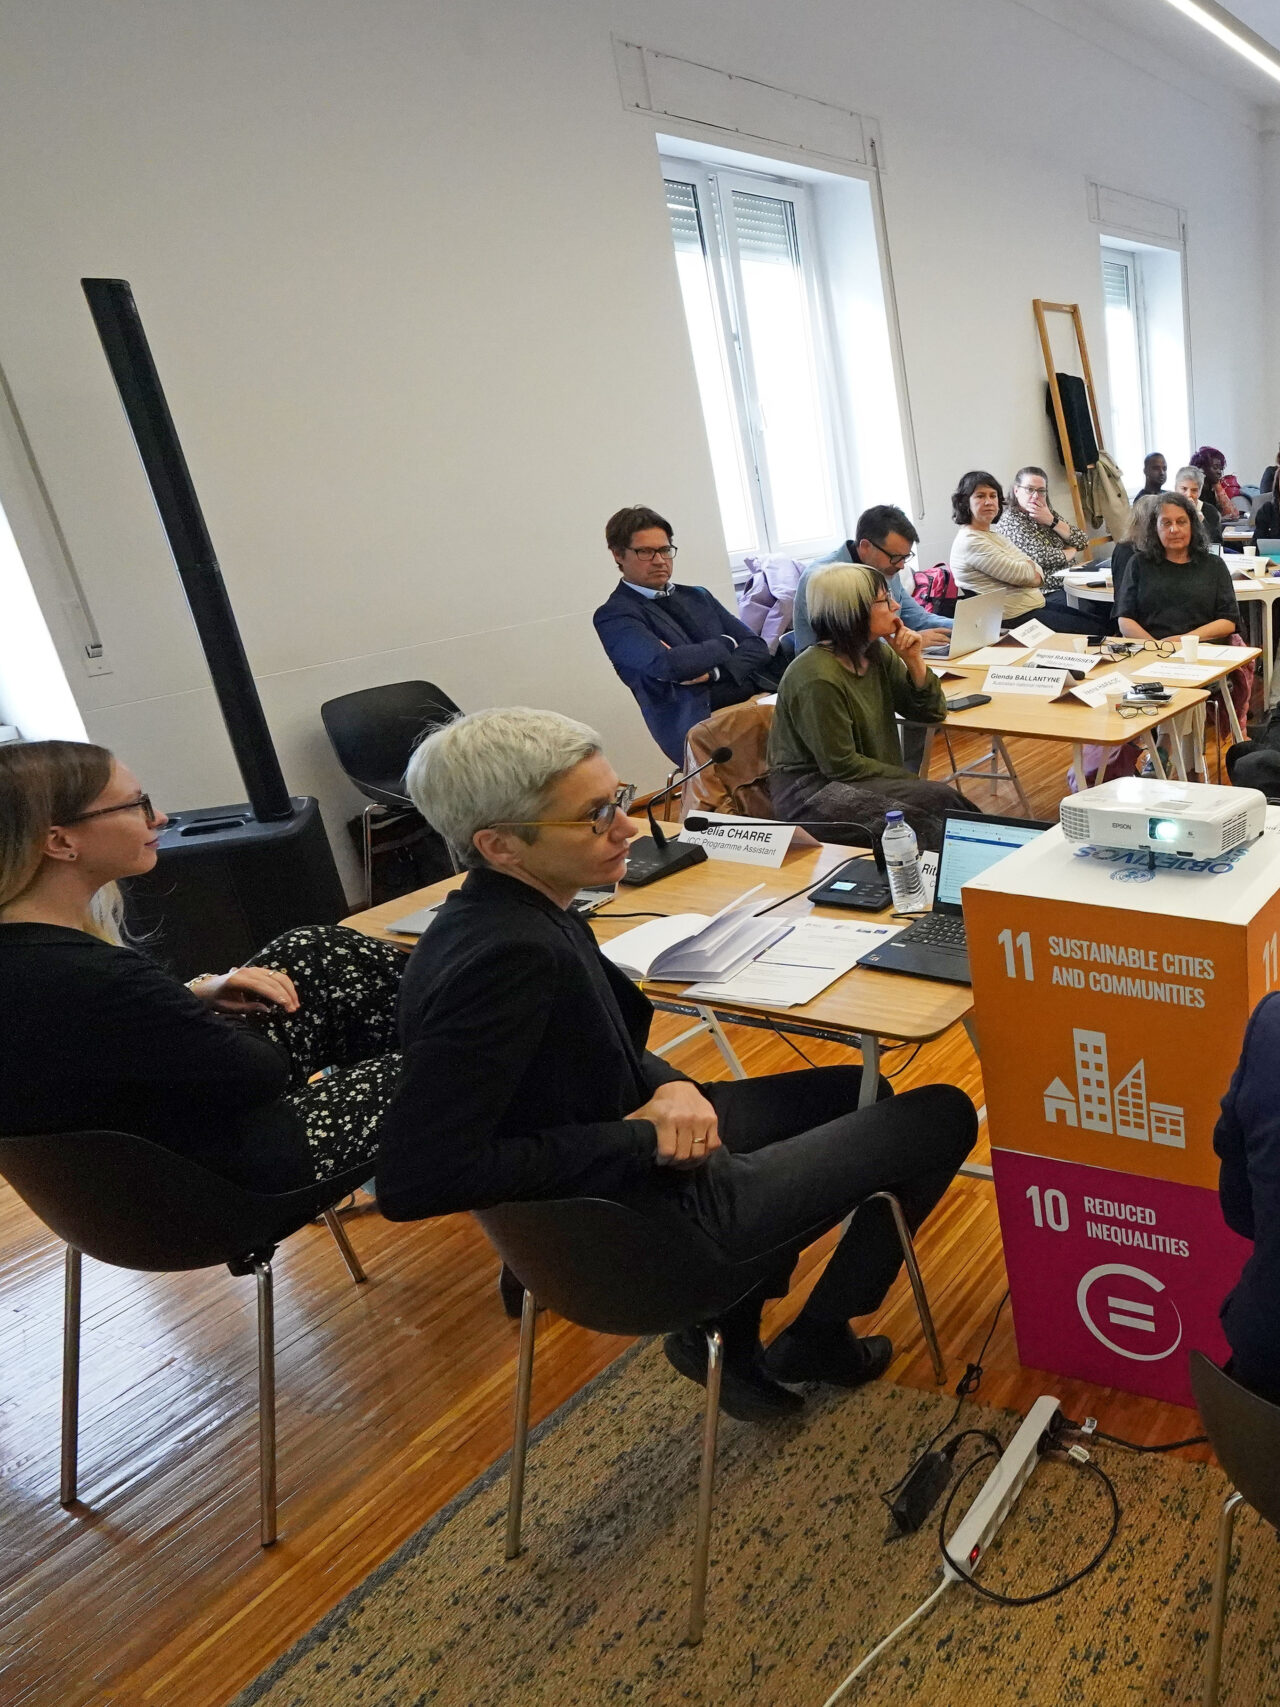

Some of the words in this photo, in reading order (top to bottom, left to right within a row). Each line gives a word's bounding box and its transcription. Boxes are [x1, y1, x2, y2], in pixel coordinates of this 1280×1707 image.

[990, 673, 1014, 681] Glenda
[1015, 674, 1061, 683] BALLANTYNE
[727, 828, 773, 843] CHARRE
[1112, 822, 1132, 830] EPSON
[702, 839, 742, 851] Programme
[743, 844, 776, 856] Assistant
[997, 928, 1035, 982] 11
[1048, 936, 1159, 972] SUSTAINABLE
[1161, 953, 1216, 980] CITIES
[1262, 931, 1278, 992] 11
[1052, 965, 1086, 990] AND
[1089, 971, 1206, 1009] COMMUNITIES
[1025, 1185, 1070, 1232] 10
[1083, 1196, 1156, 1226] REDUCED
[1086, 1221, 1190, 1258] INEQUALITIES
